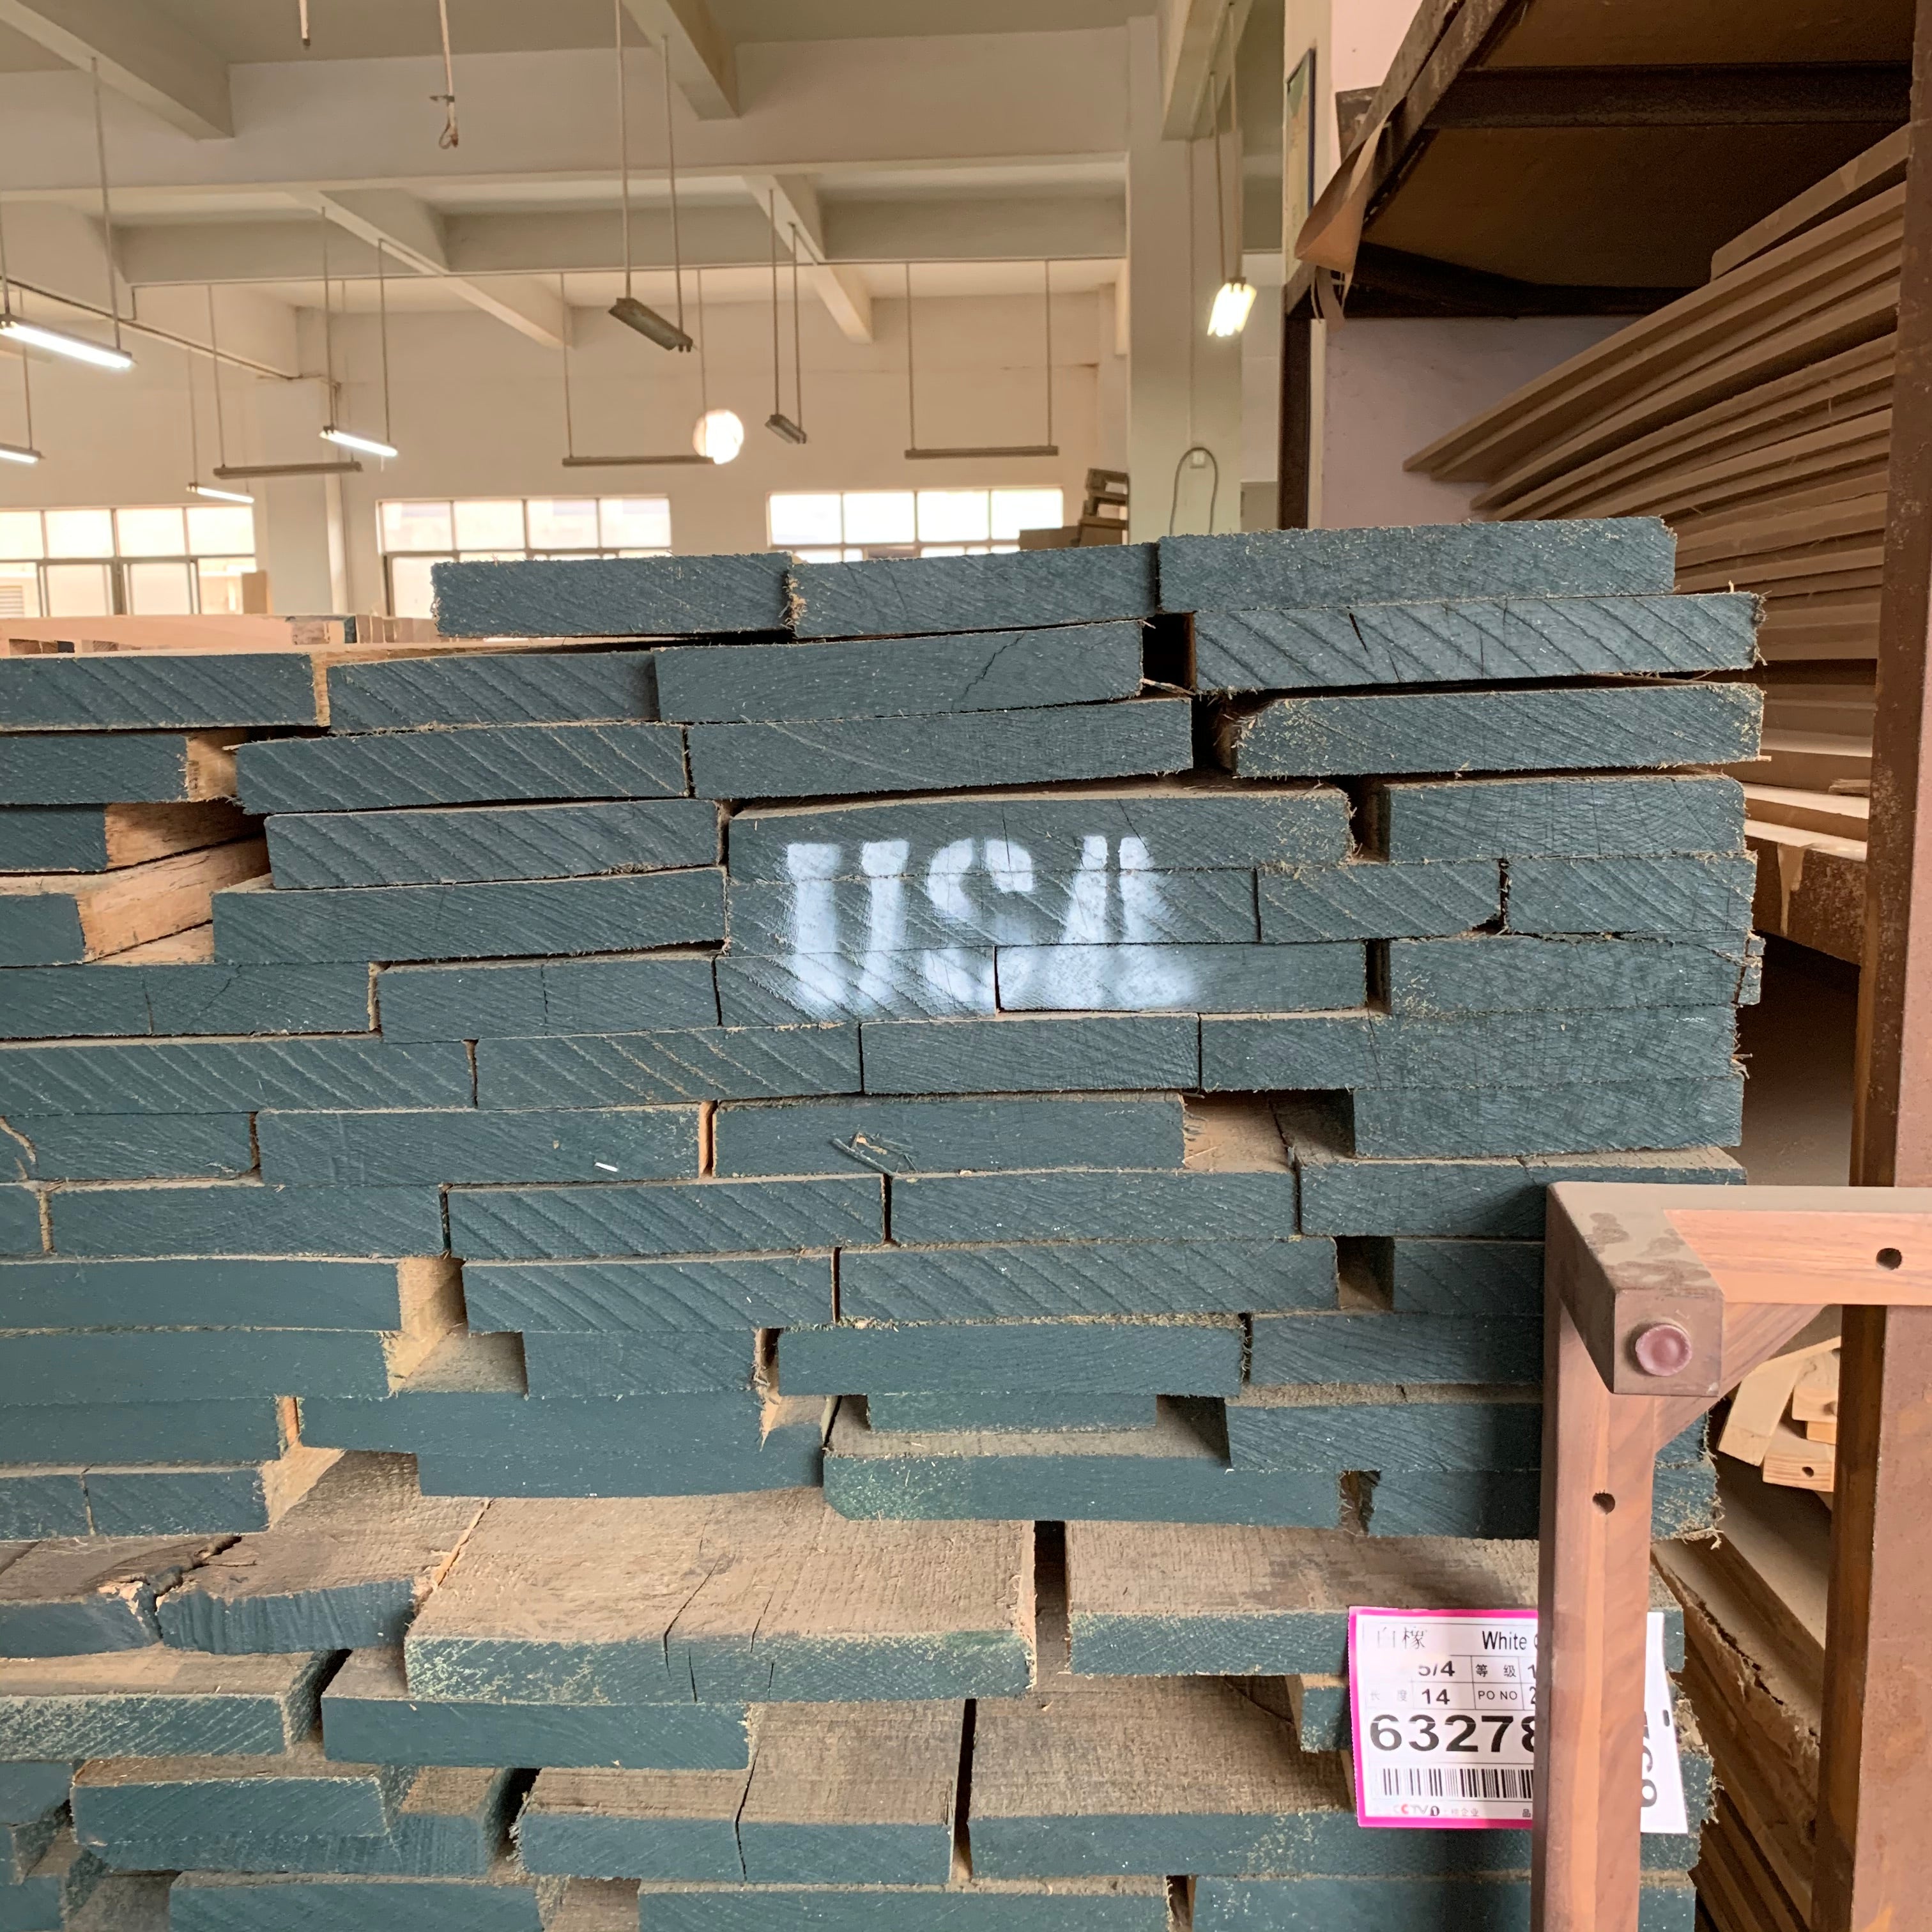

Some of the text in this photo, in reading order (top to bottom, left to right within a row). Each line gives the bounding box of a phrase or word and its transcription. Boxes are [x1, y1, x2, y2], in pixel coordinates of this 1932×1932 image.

[783, 835, 1197, 1016] USA
[1482, 1630, 1527, 1650] White
[1417, 1660, 1455, 1678] 5/4
[1421, 1688, 1450, 1705] 14
[1477, 1690, 1518, 1700] PO NO
